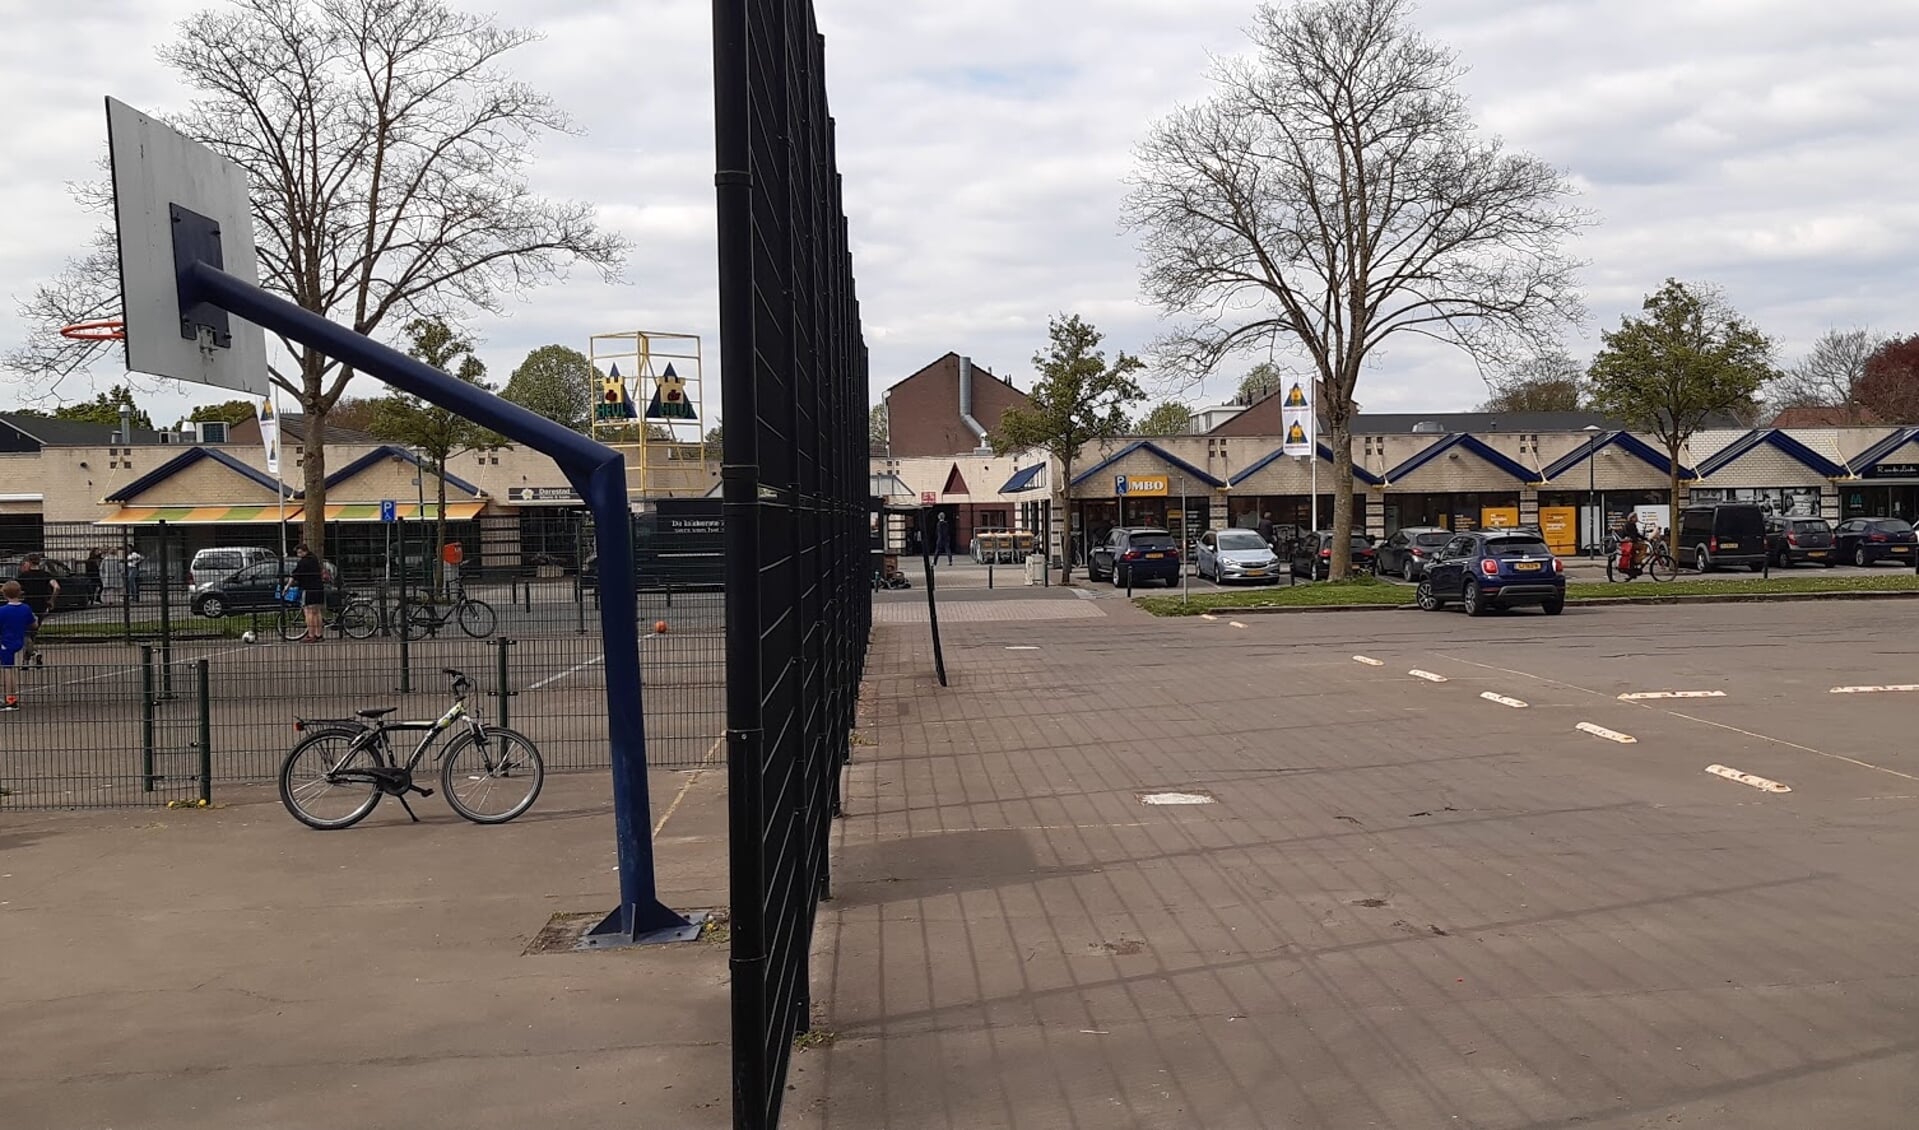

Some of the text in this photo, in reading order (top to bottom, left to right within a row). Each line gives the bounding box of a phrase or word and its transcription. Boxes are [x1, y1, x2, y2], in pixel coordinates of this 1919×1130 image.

[597, 403, 627, 418] HEUL
[1117, 475, 1125, 487] P
[1128, 480, 1164, 491] MBO
[383, 501, 393, 513] P
